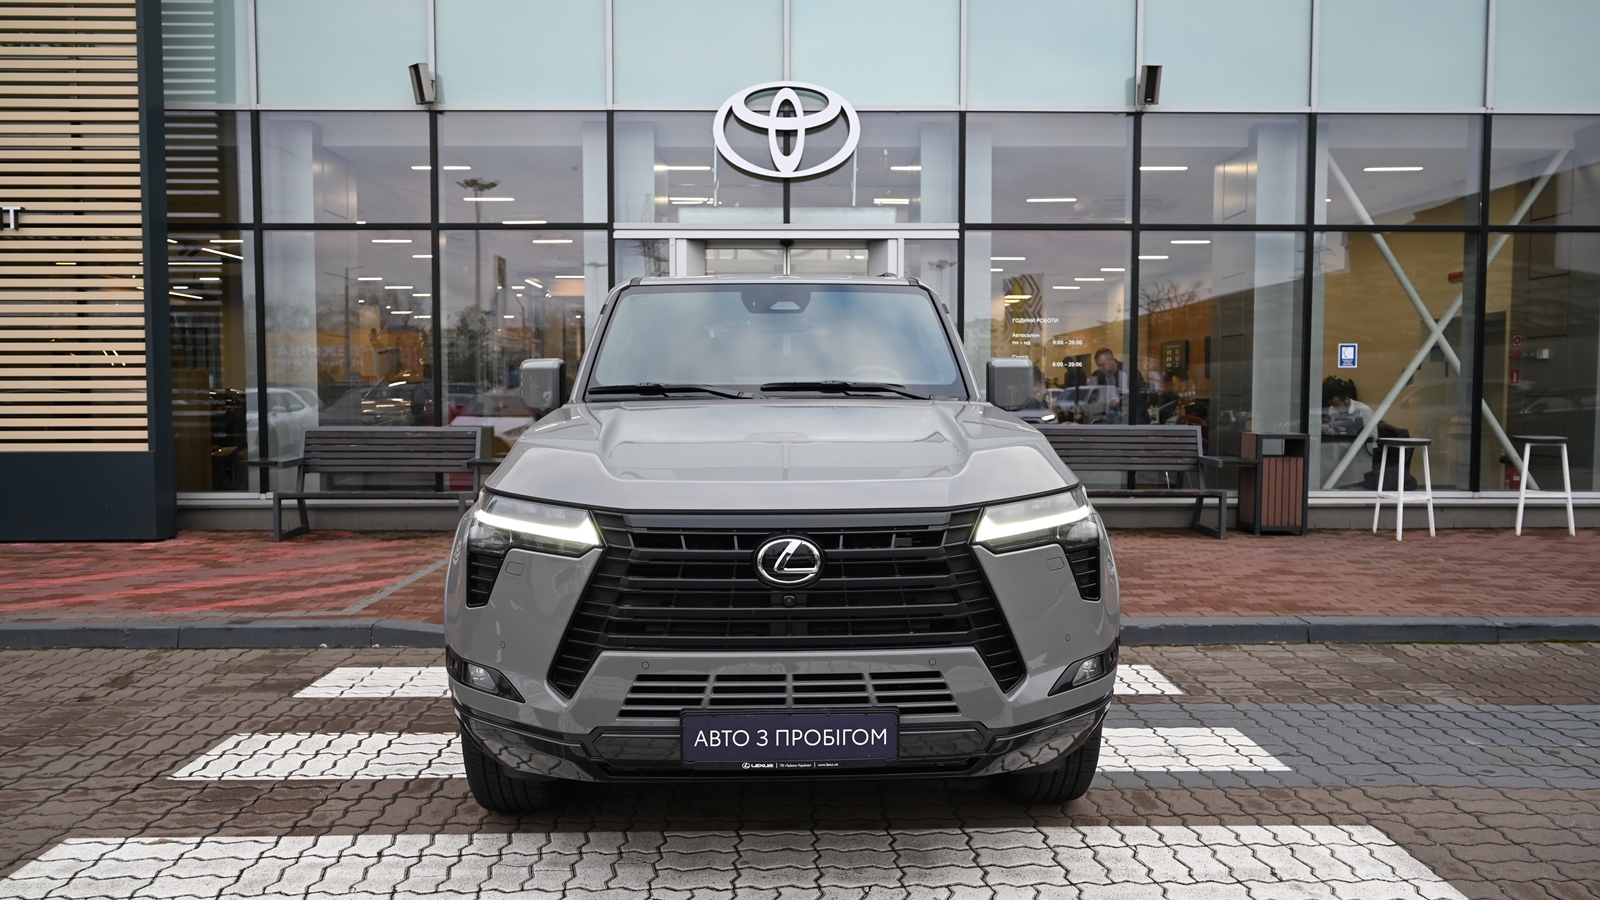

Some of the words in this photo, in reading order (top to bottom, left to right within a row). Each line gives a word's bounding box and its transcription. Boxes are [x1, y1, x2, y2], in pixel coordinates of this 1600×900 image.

[694, 730, 750, 747] АВТО
[756, 730, 769, 747] З
[775, 728, 887, 746] ПРОБІГОМ
